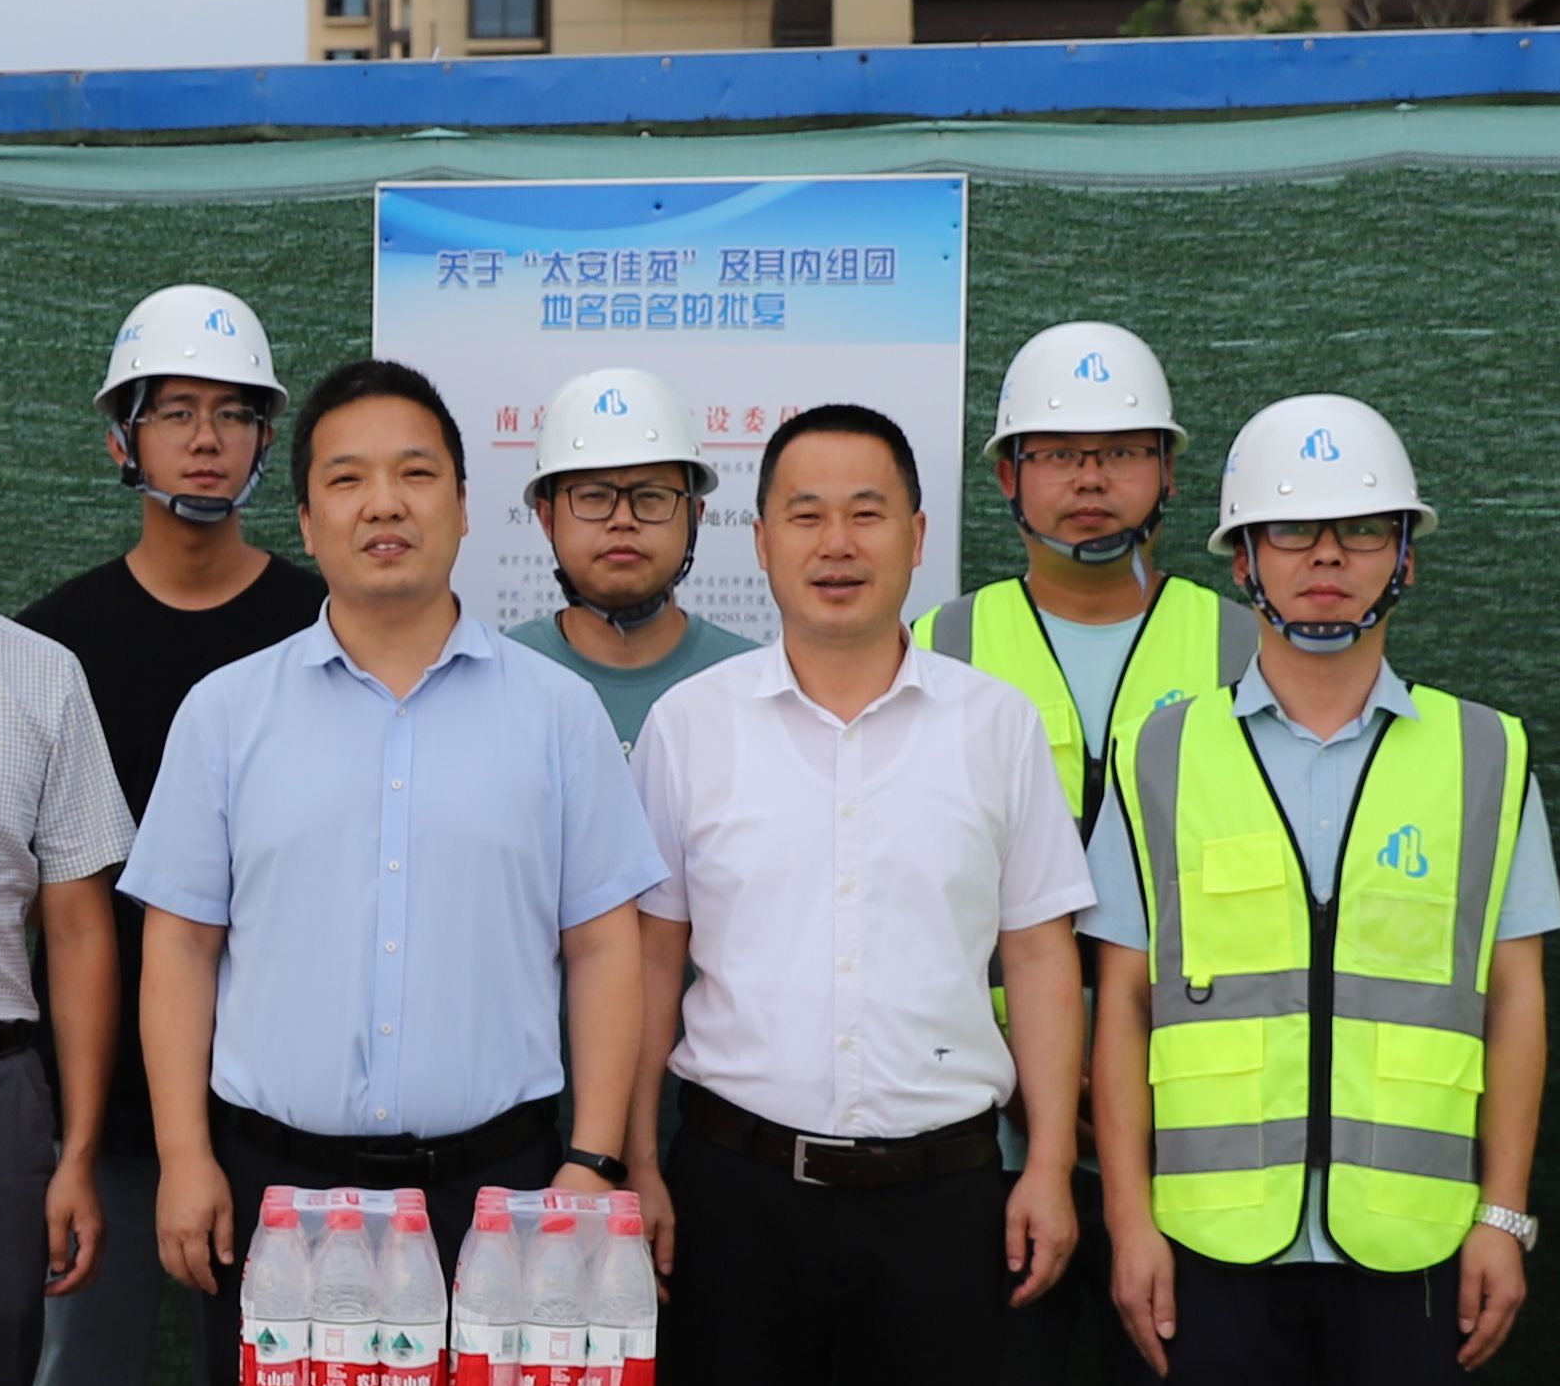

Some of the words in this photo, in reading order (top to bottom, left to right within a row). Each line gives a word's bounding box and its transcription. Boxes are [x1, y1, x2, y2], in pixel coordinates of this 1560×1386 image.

[436, 249, 505, 289] 关于
[717, 246, 897, 283] 及其内组团
[540, 291, 787, 331] 地名命名的批复
